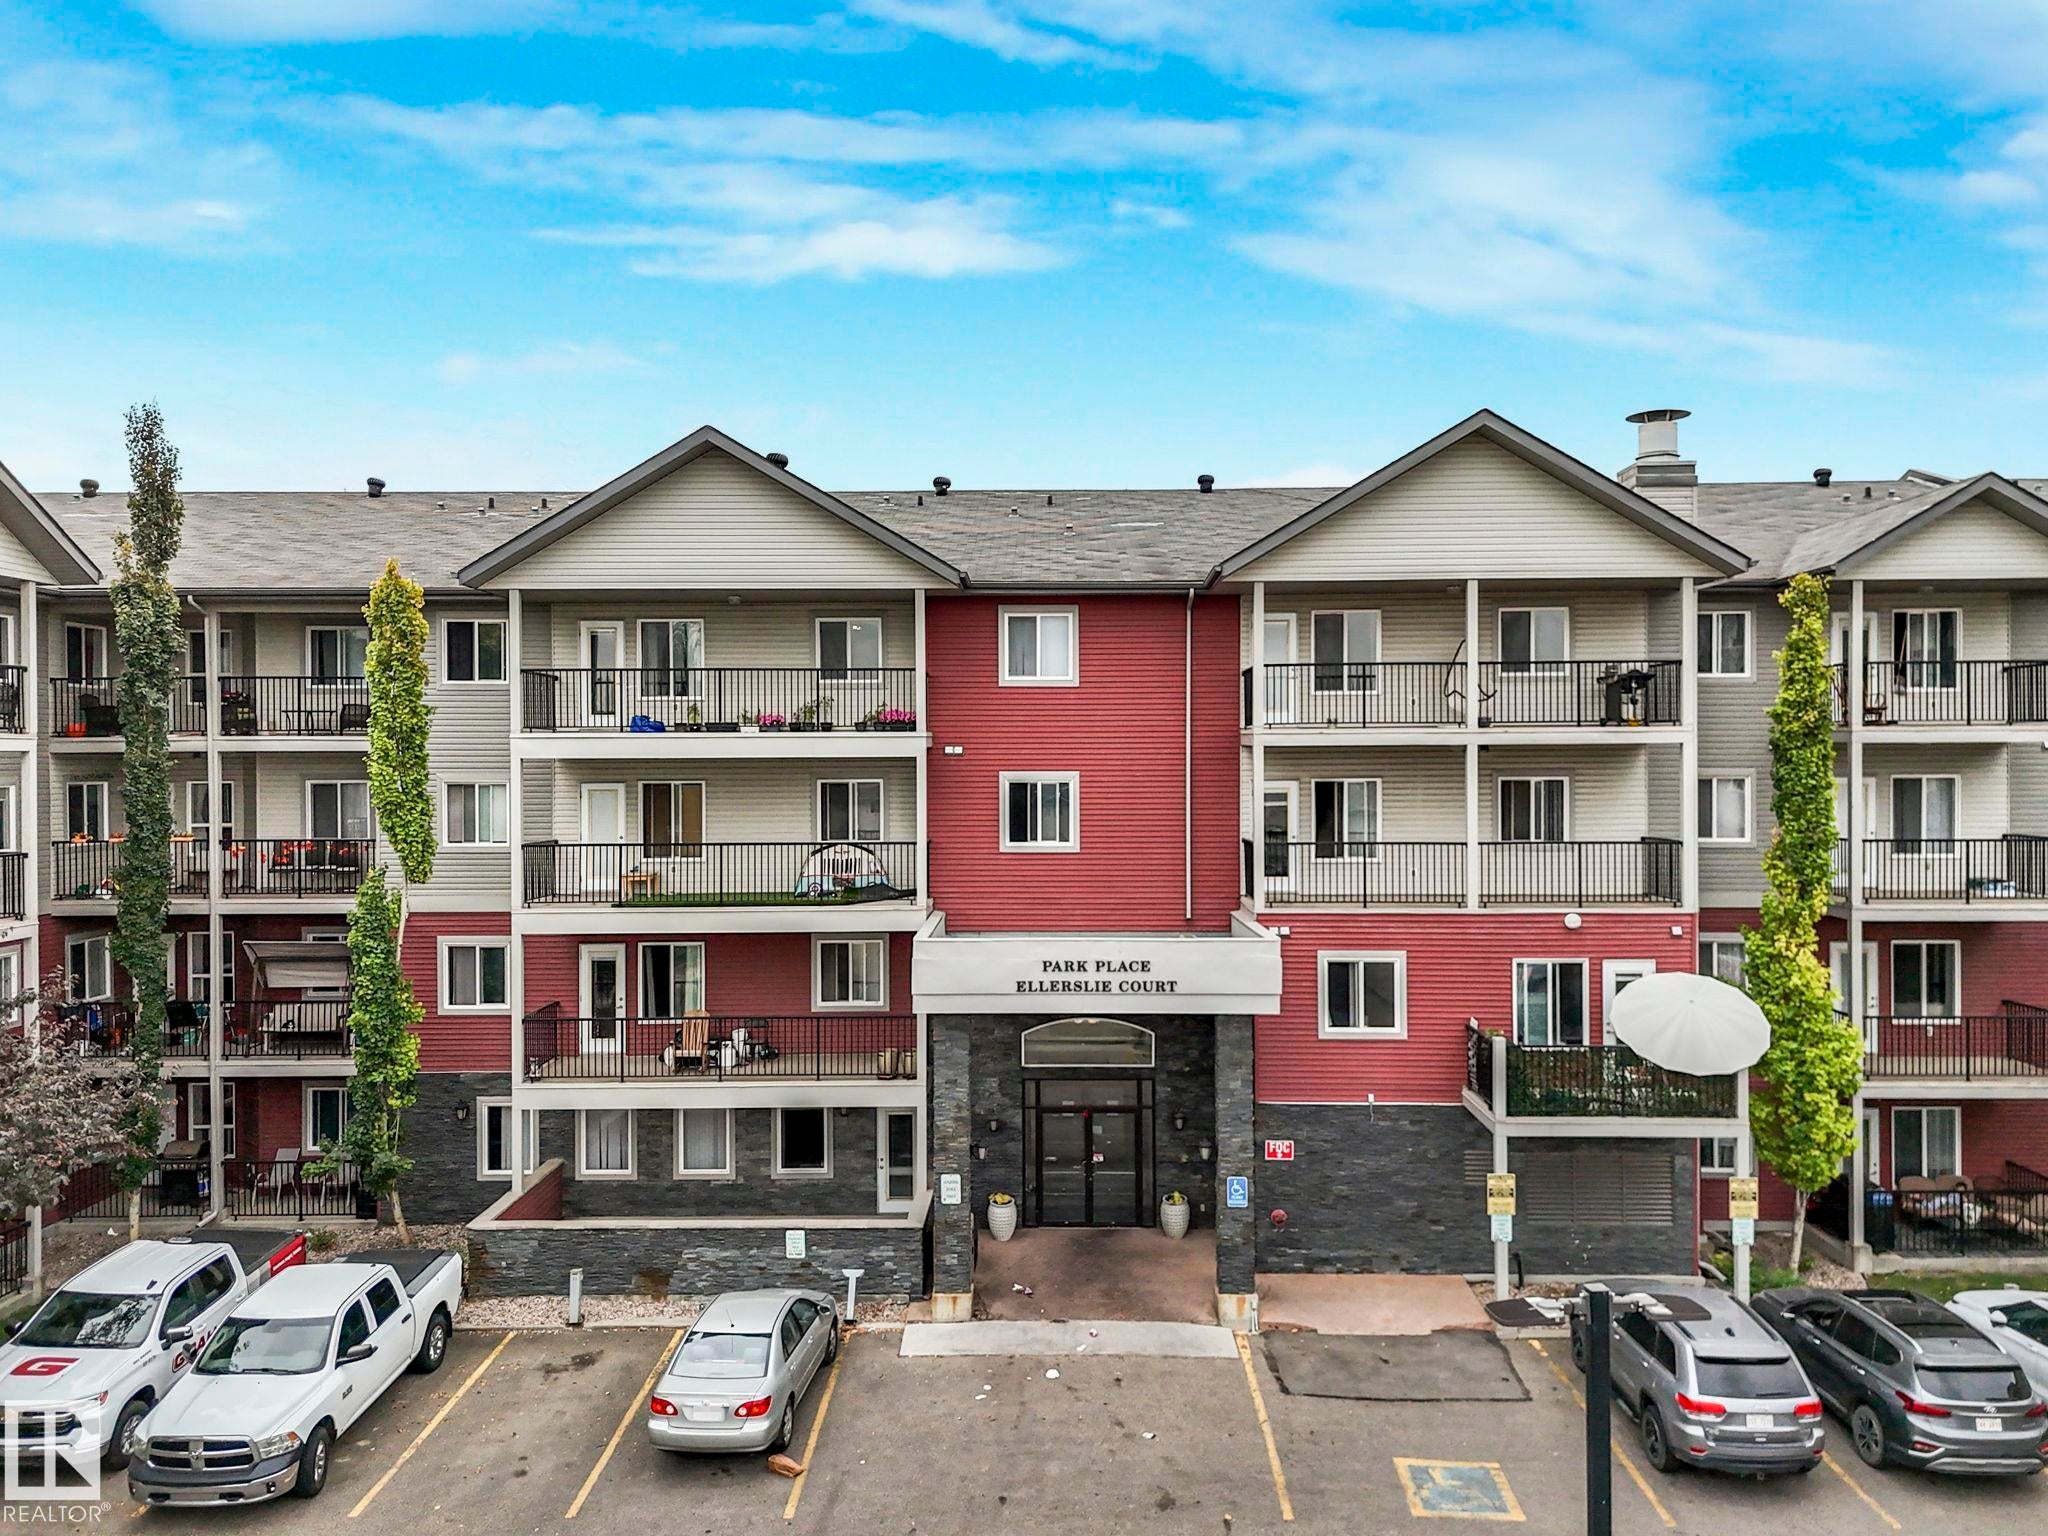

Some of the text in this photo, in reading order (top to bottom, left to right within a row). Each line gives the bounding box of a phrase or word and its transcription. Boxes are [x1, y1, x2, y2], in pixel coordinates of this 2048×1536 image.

[1042, 960, 1151, 972] PARK PLACE
[1016, 980, 1178, 992] ELLERSLIE COURT
[1269, 1140, 1291, 1153] FDC
